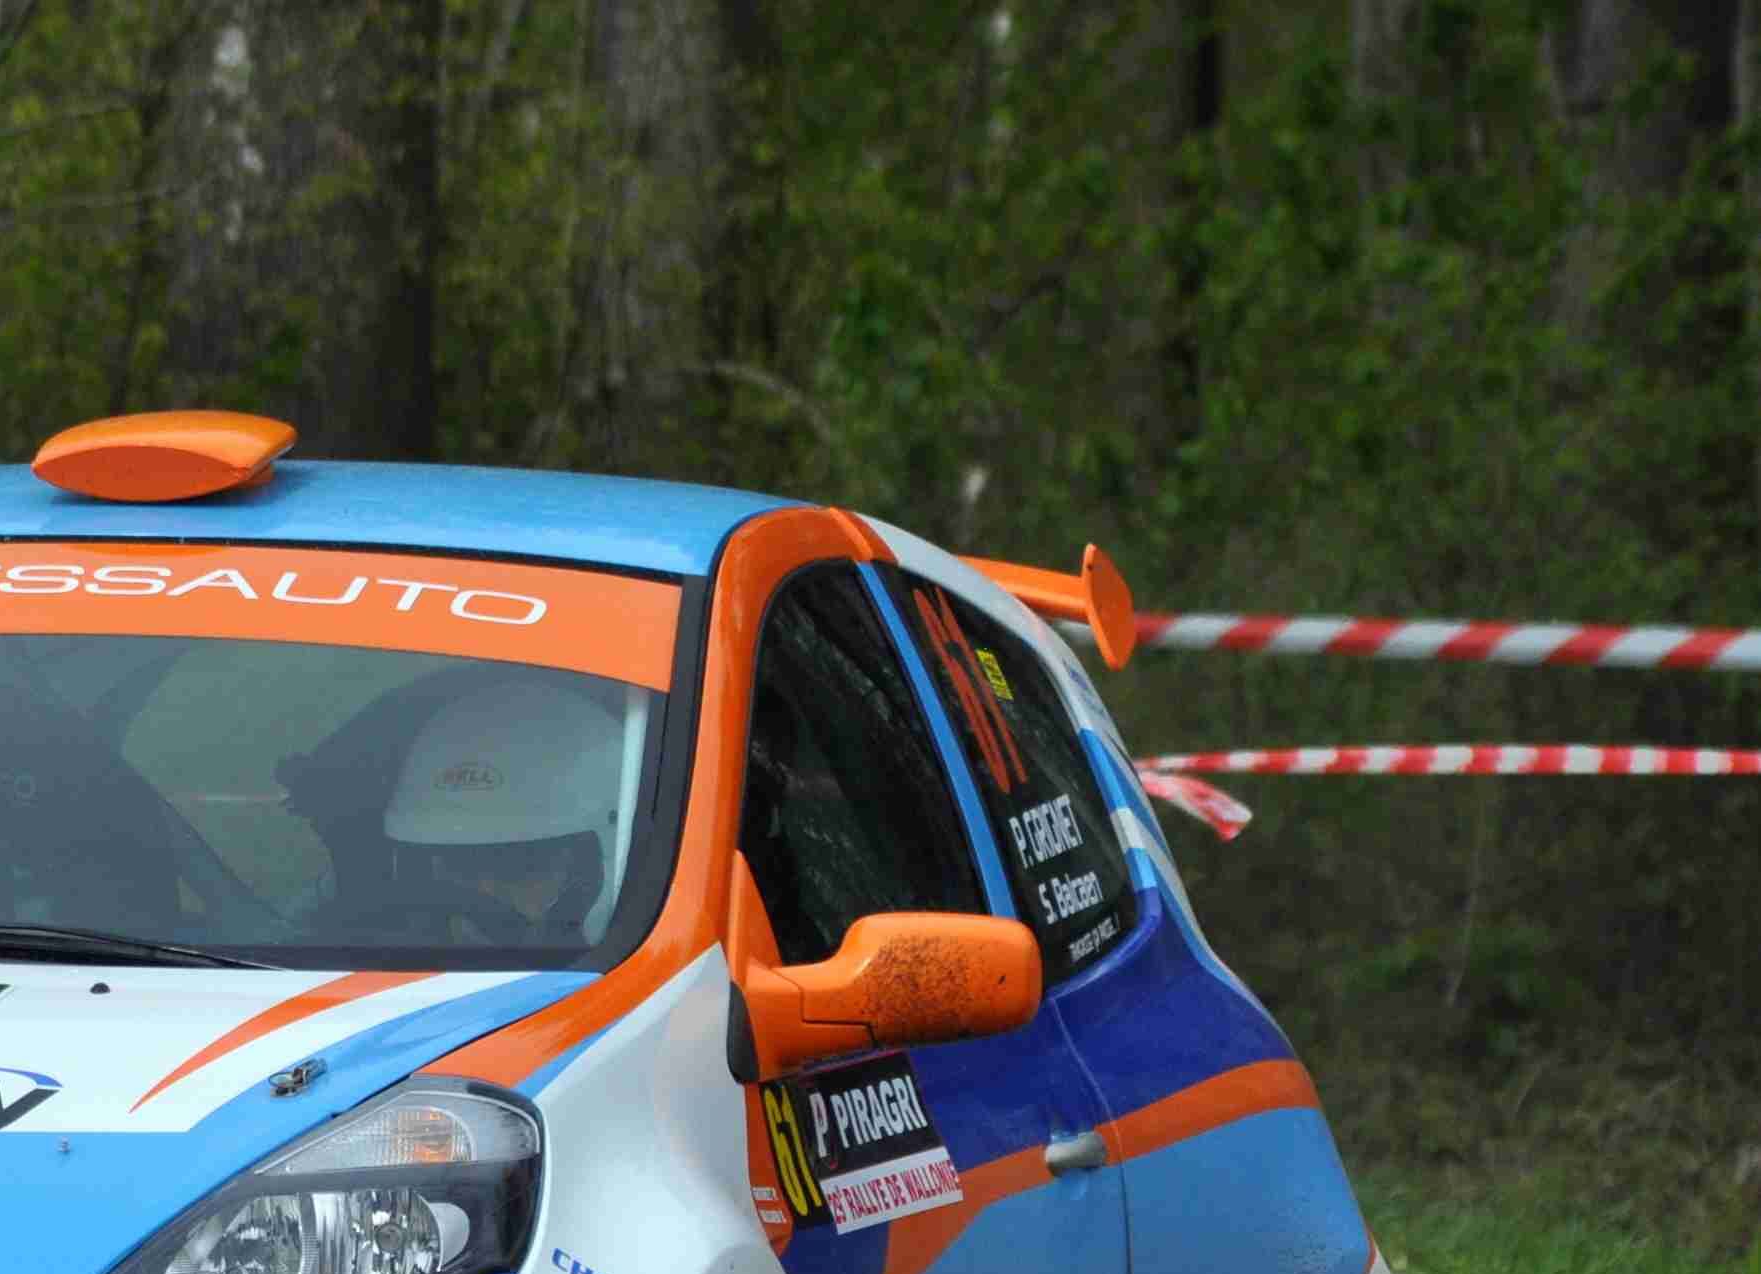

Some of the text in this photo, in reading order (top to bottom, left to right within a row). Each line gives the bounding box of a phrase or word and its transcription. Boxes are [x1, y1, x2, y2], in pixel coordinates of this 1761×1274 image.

[831, 1074, 928, 1149] PIRAGRI
[764, 1084, 823, 1216] 61
[842, 1178, 890, 1221] RALLYE
[885, 1174, 906, 1208] DE
[902, 1160, 961, 1203] WALLONIE
